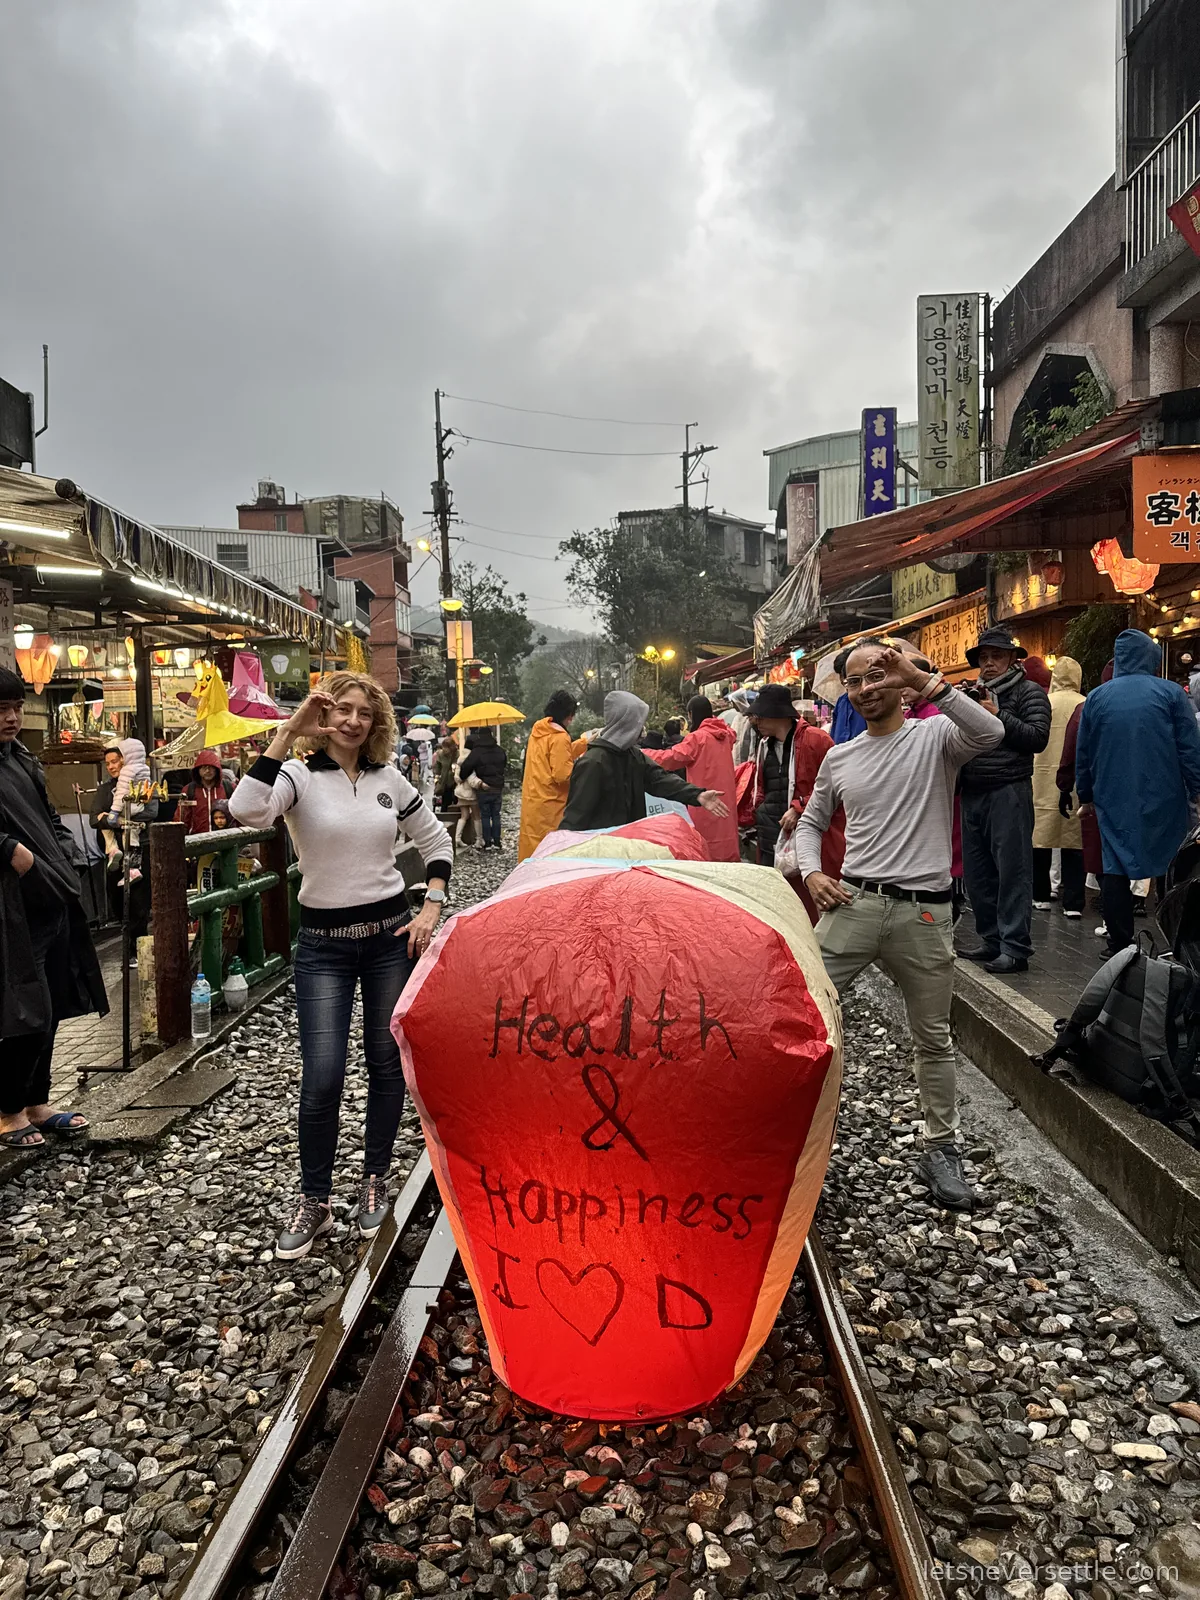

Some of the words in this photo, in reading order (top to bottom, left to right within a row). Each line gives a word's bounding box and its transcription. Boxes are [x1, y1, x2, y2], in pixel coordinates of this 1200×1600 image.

[924, 300, 953, 401] 가용엄마
[955, 299, 973, 386] 佳蓉媽媽
[924, 419, 953, 470] 천등
[955, 398, 974, 440] 天燈
[870, 413, 891, 517] 吉利天
[488, 988, 738, 1061] Health
[581, 1063, 649, 1162] &
[480, 1165, 764, 1248] Happiness
[489, 1245, 530, 1310] I
[656, 1274, 713, 1330] D
